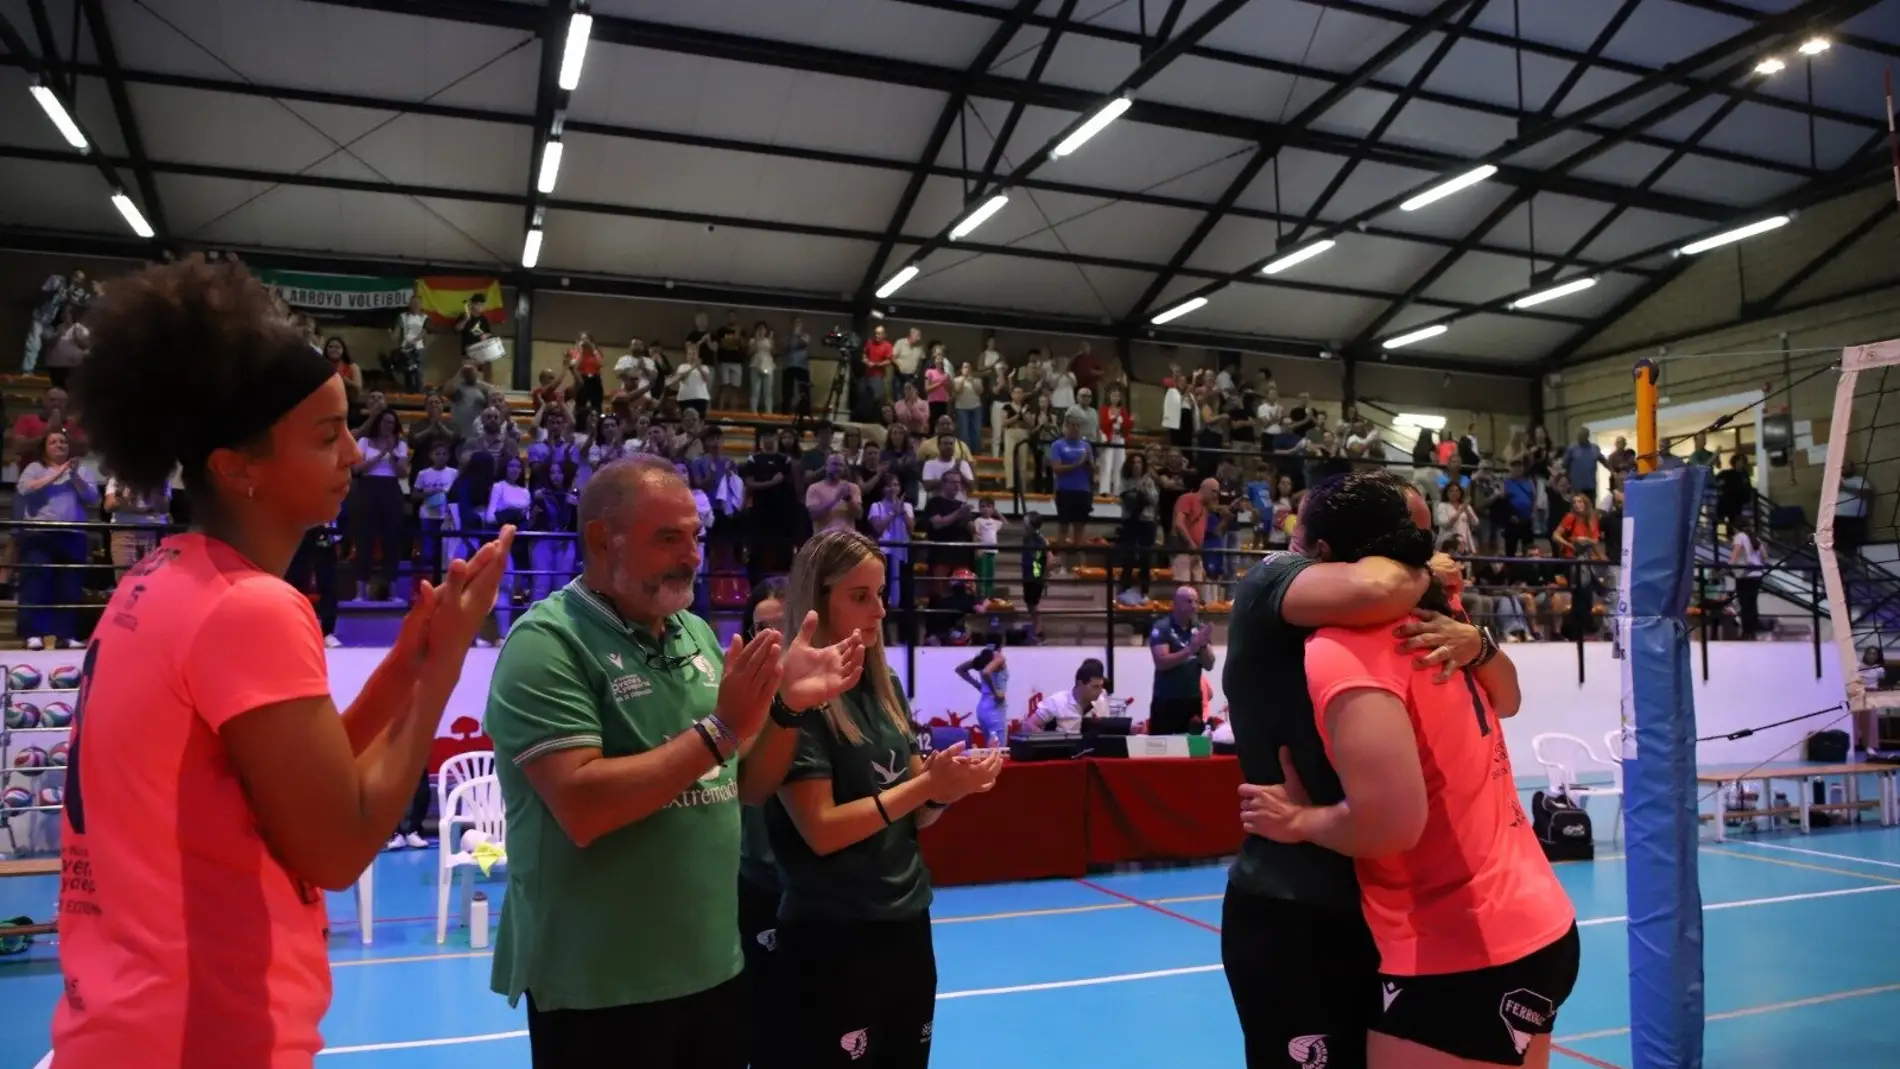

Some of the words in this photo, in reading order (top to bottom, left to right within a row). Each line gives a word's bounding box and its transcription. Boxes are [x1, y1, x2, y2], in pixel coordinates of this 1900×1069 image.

[290, 289, 342, 307] ARROYO
[348, 291, 408, 307] VOLEIBOL
[916, 732, 933, 751] 12
